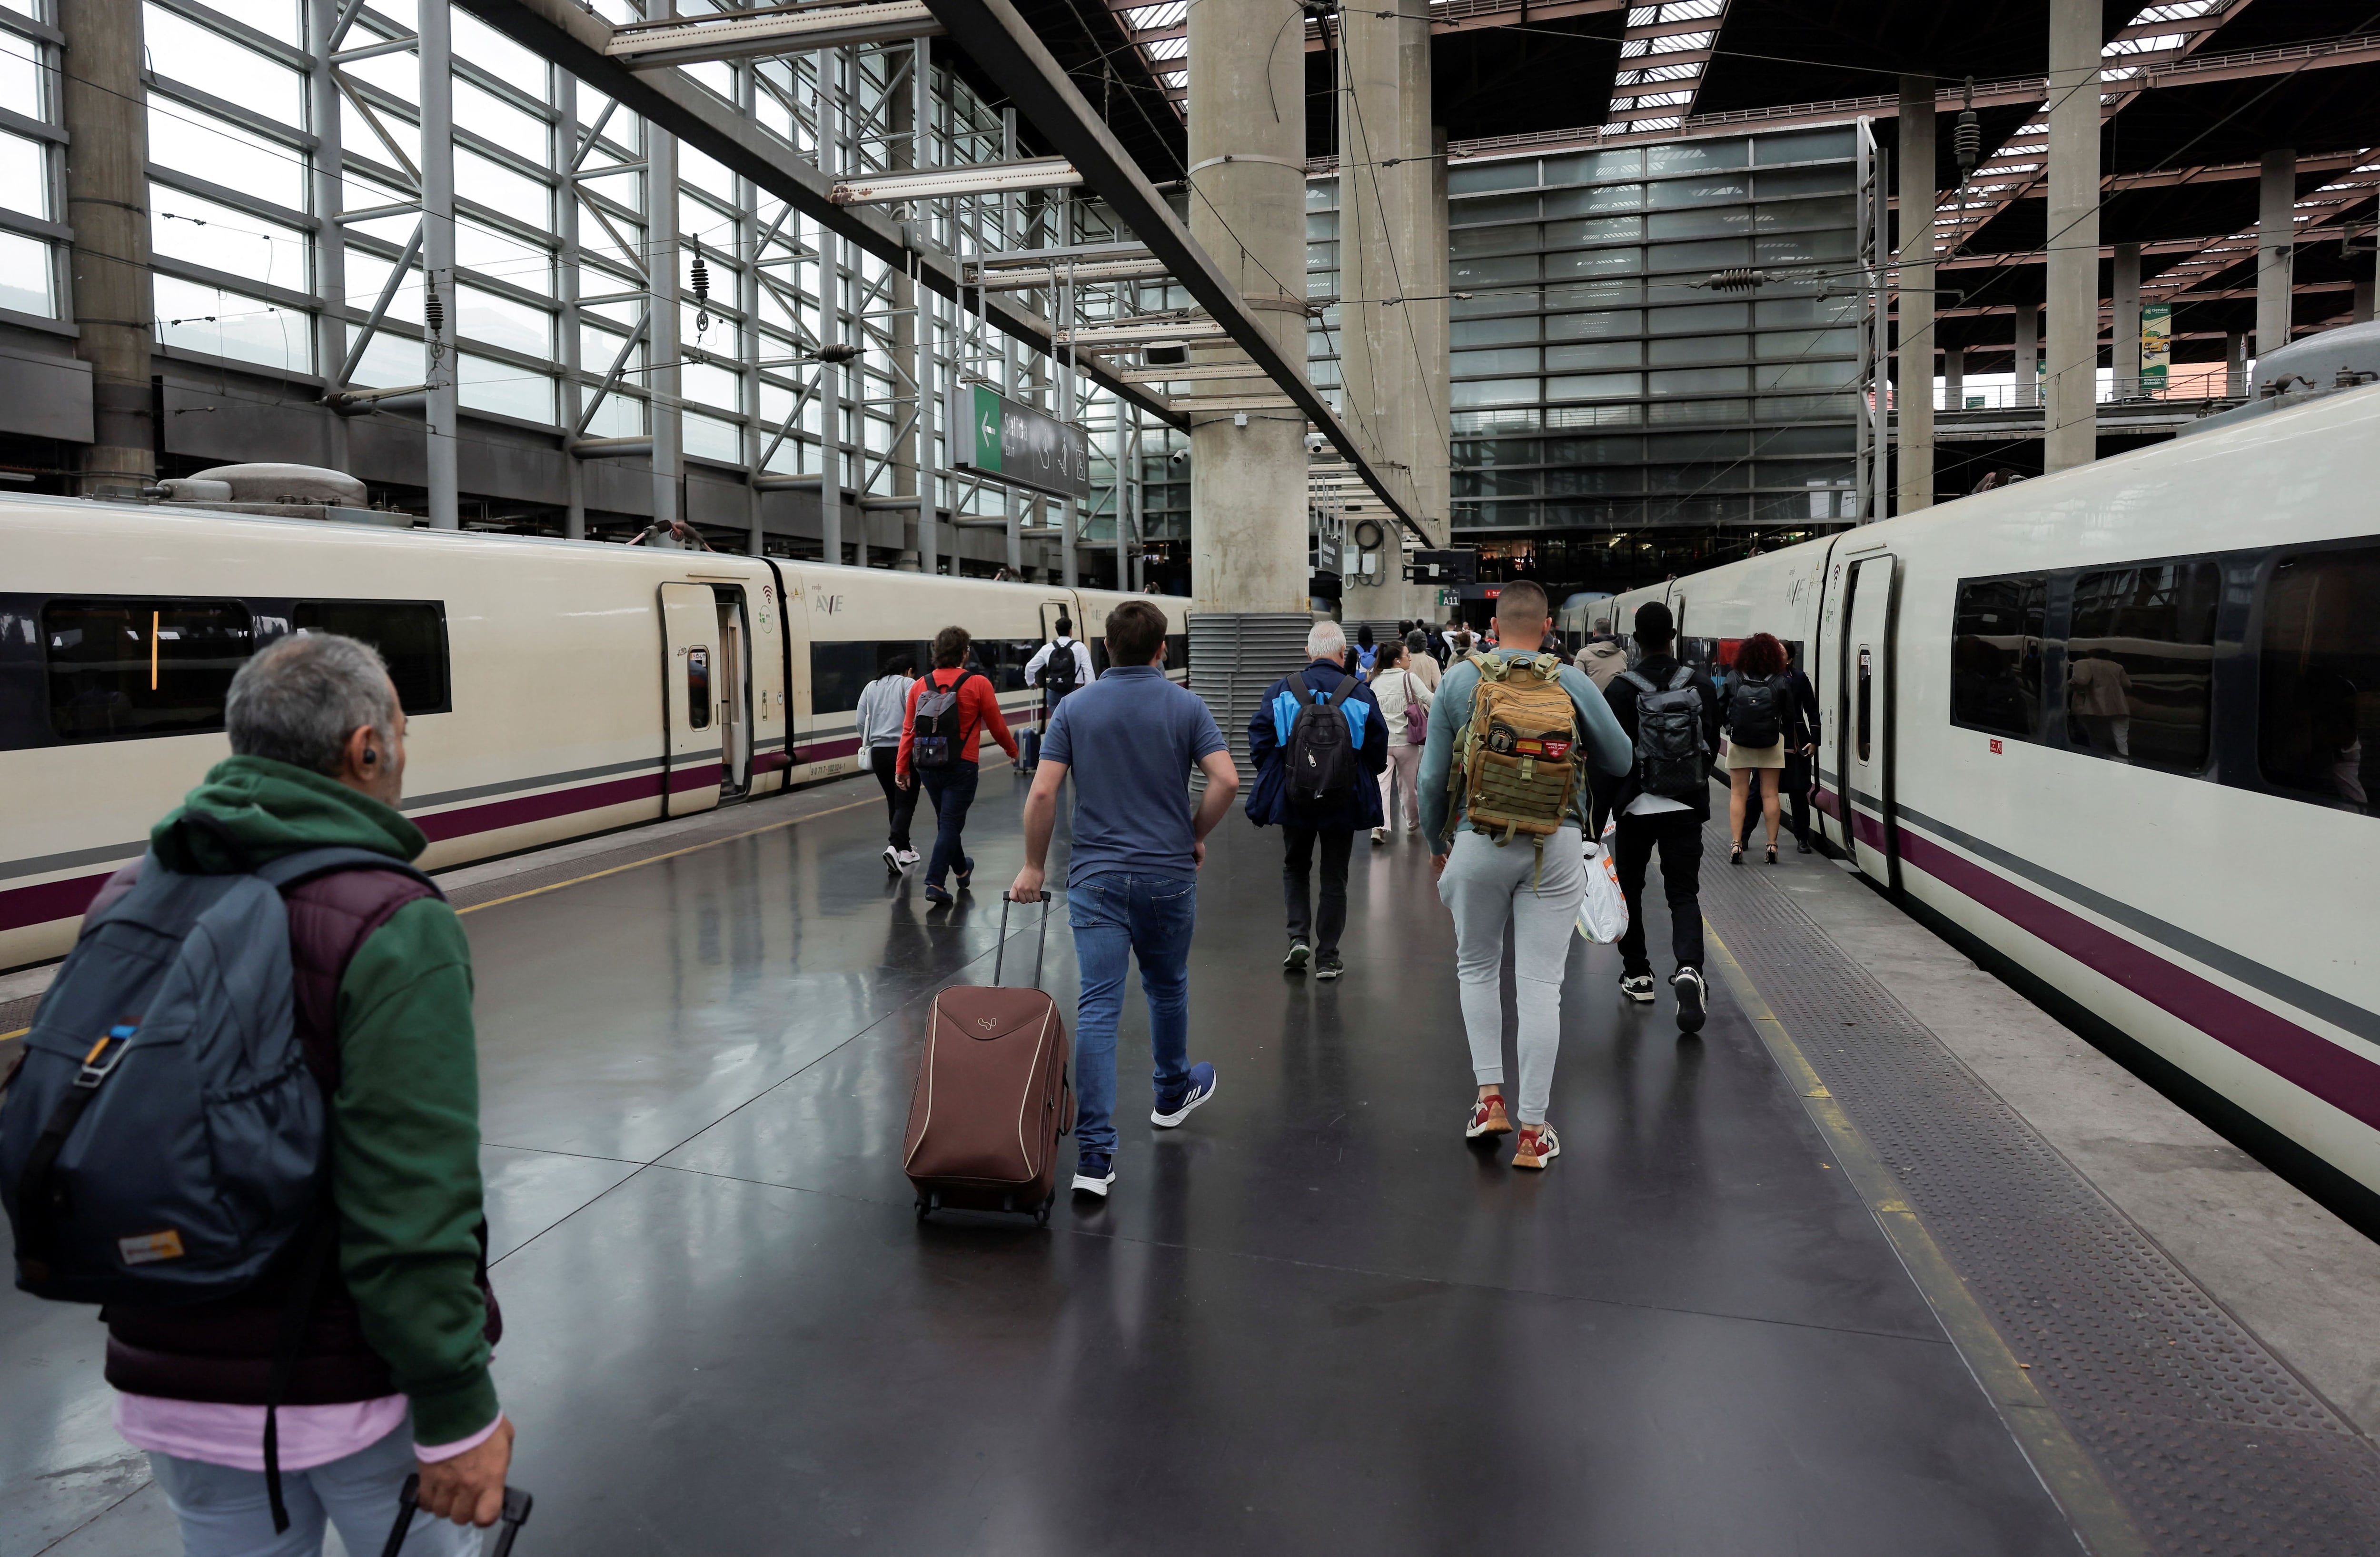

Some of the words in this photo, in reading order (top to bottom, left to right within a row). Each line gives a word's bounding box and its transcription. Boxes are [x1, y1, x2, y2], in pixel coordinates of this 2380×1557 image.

[1005, 412, 1028, 441] Salida
[1005, 445, 1015, 458] EXIT
[1443, 597, 1458, 605] A11
[1785, 578, 1806, 608] AVE
[815, 595, 843, 616] AVE
